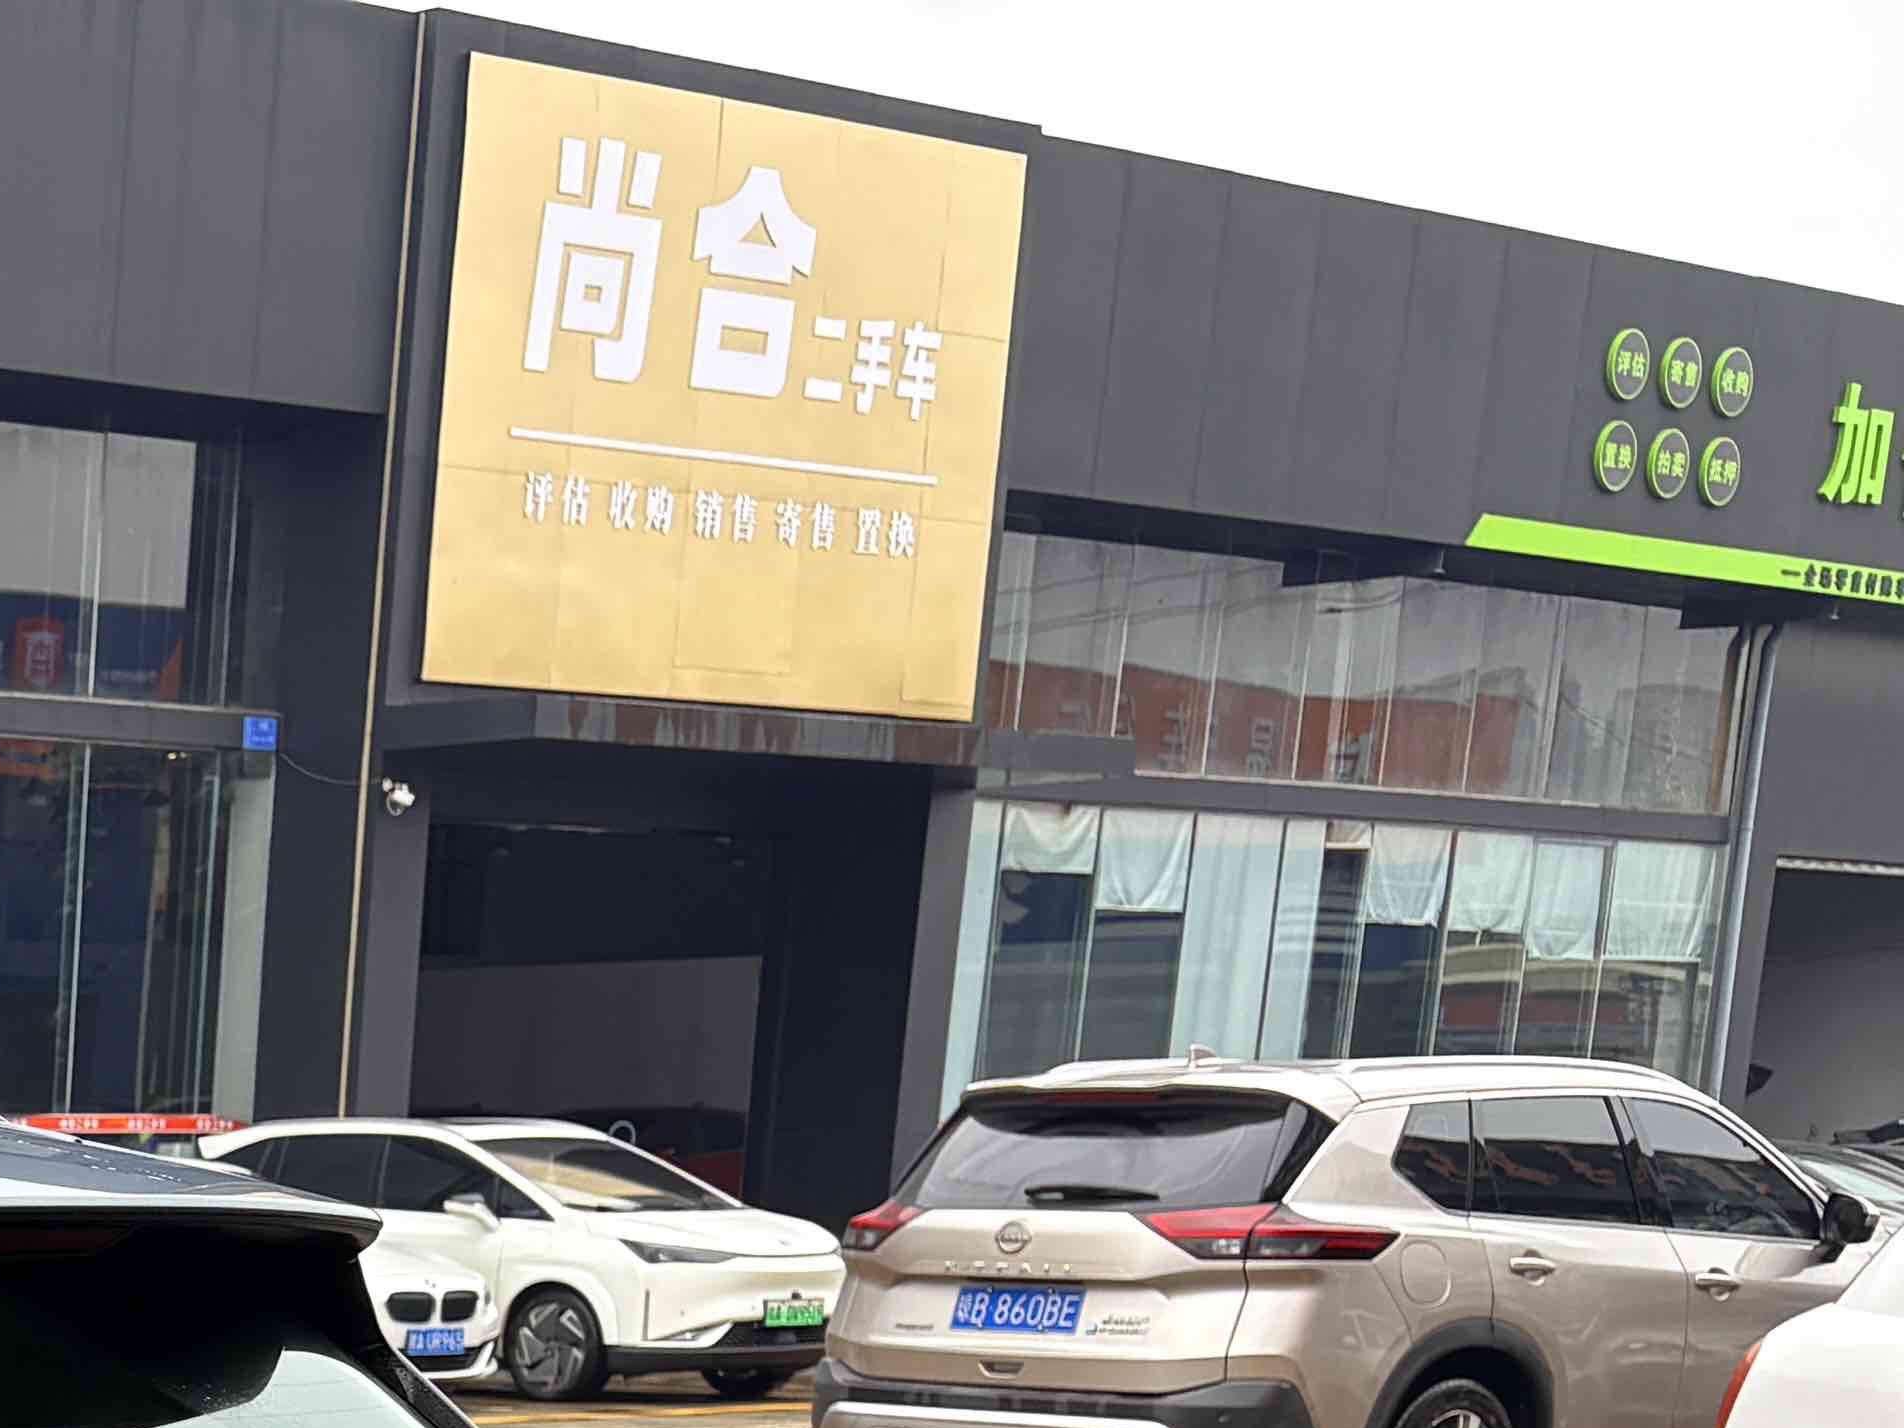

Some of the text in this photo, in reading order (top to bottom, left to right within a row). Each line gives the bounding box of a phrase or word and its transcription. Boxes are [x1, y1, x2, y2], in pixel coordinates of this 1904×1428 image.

[522, 135, 943, 422] 尚合 二手车
[522, 470, 589, 526] 评估
[607, 479, 675, 537] 收购
[1816, 381, 1896, 505] 加
